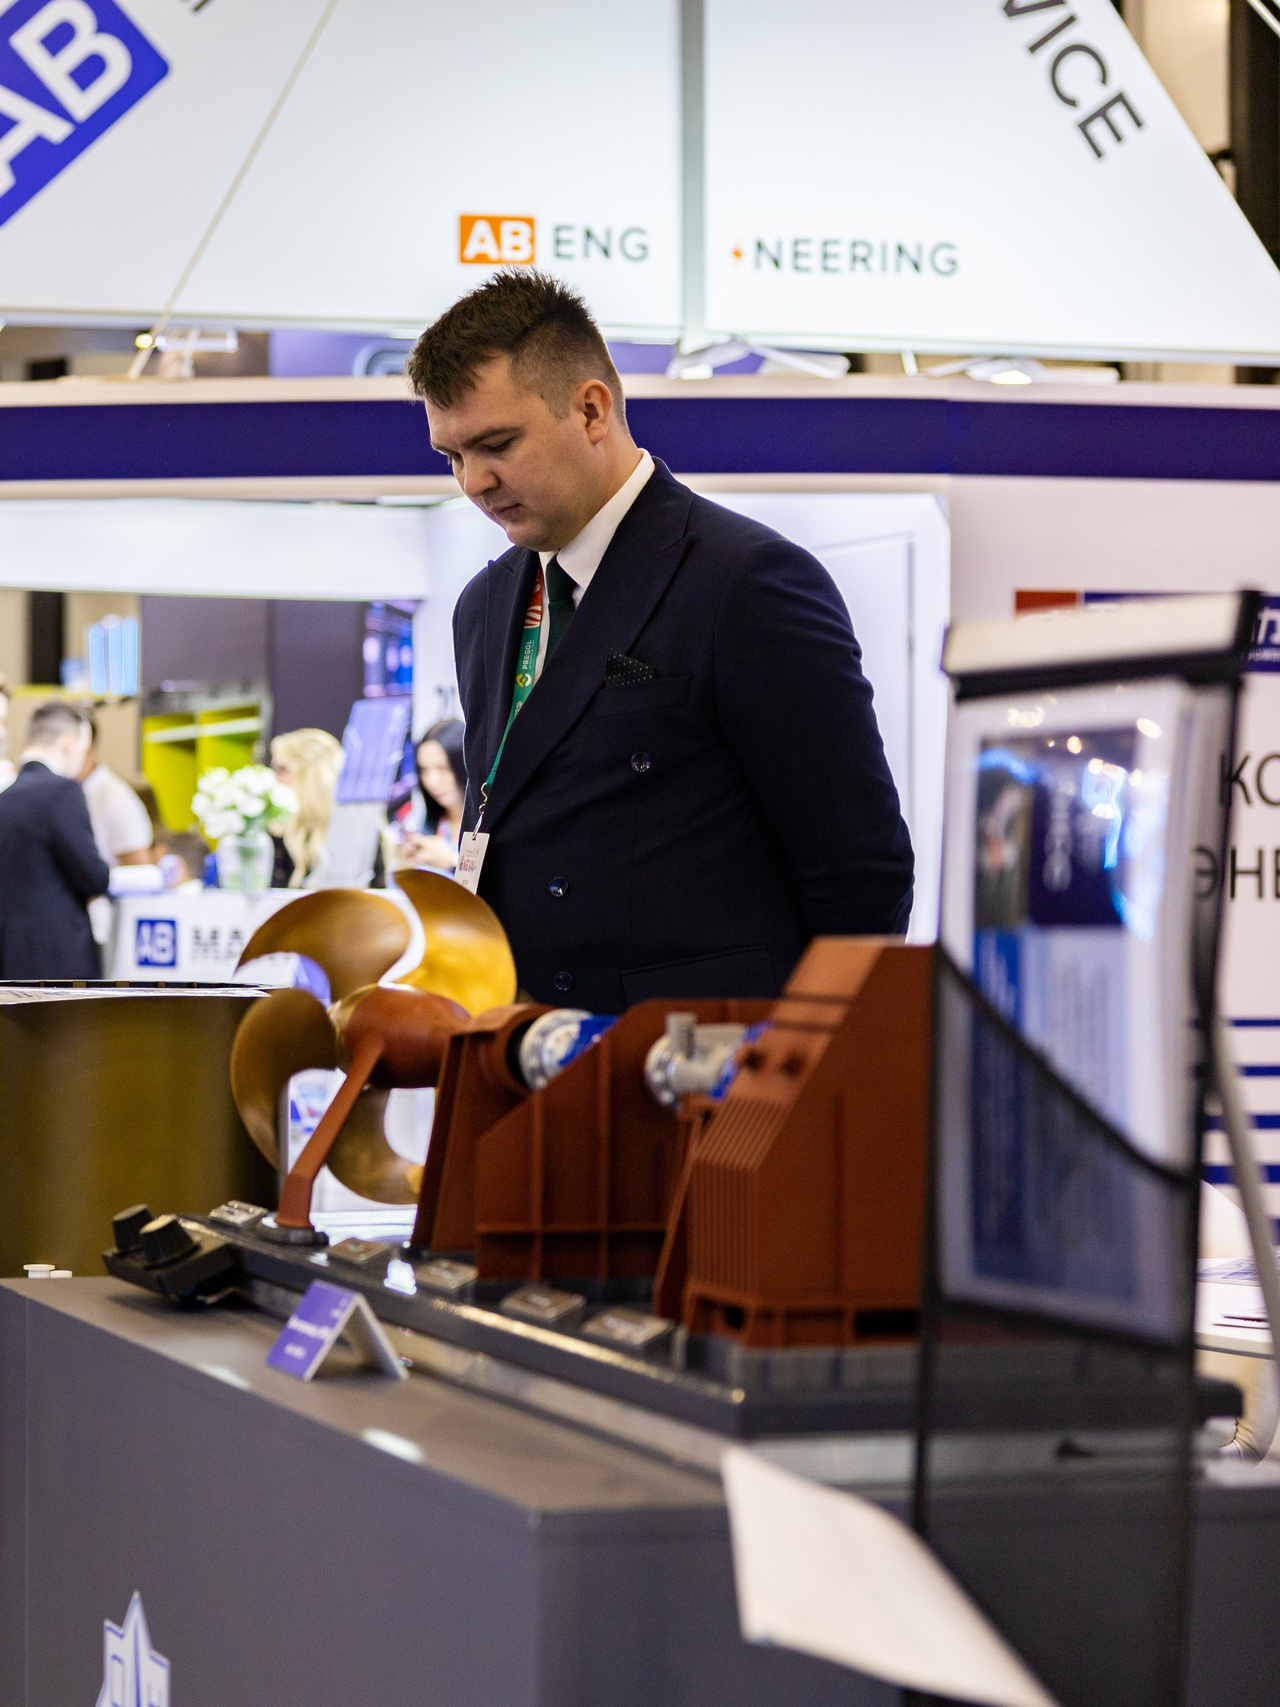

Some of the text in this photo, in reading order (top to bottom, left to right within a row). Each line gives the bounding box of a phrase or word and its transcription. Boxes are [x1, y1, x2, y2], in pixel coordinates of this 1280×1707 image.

[463, 219, 533, 261] AB
[553, 225, 650, 261] ENG
[522, 640, 533, 670] PREGOL
[1194, 846, 1280, 900] ЭН
